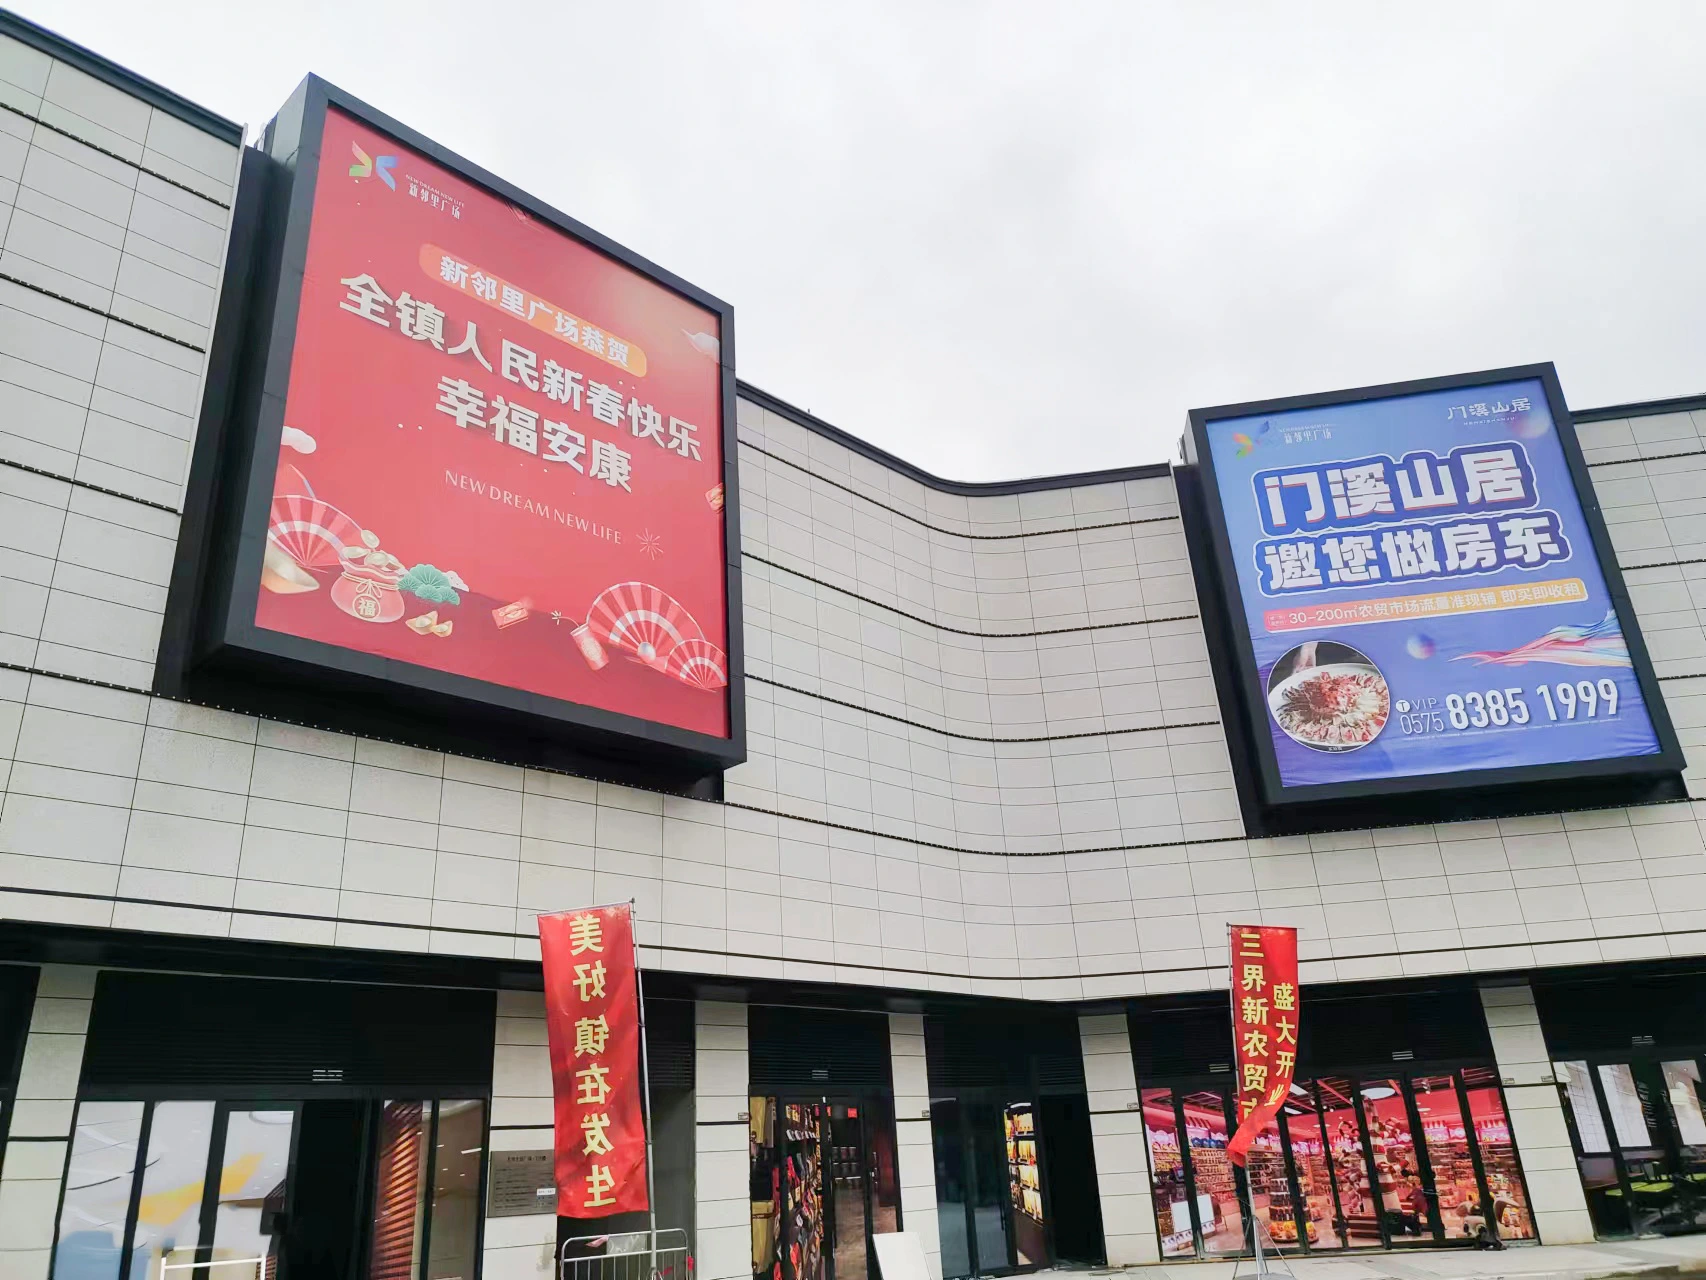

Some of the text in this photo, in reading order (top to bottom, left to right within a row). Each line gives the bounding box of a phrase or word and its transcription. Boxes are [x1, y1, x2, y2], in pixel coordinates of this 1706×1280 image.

[440, 255, 630, 370] 新邻里广场恭贺
[339, 272, 702, 462] 全镇人民新春快乐
[436, 375, 632, 493] 幸福安康
[1447, 397, 1531, 420] 门溪山居
[445, 470, 622, 545] NEW DREAM NEW LIFE
[1263, 449, 1526, 527] 门溪山居
[1264, 516, 1560, 590] 邀您做房东
[358, 597, 377, 617] 福
[1501, 582, 1581, 603] 即买即收租
[1400, 711, 1445, 735] 0575
[1446, 687, 1531, 731] 8385
[1536, 678, 1619, 721] 1999
[1412, 697, 1437, 711] VIP
